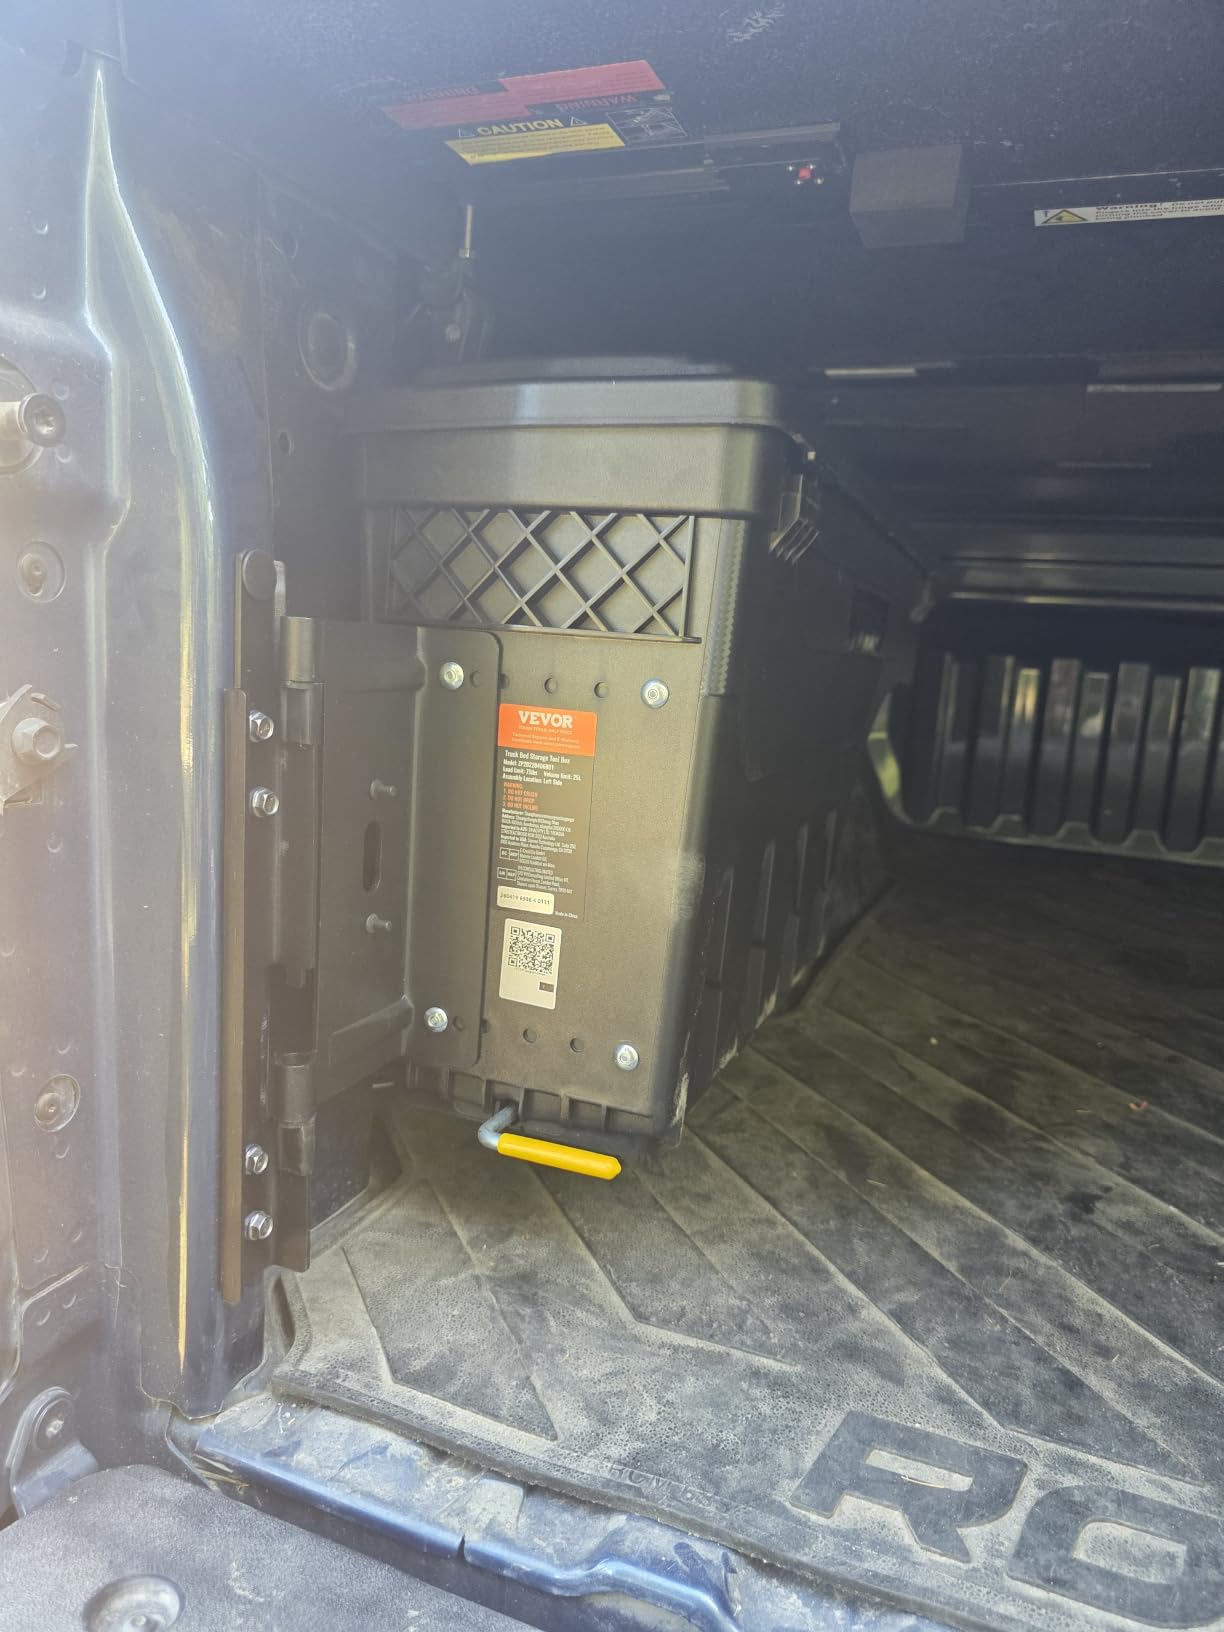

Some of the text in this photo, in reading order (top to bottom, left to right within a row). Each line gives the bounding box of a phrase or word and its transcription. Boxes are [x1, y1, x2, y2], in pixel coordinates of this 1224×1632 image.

[477, 118, 564, 136] CAUTION
[518, 710, 573, 729] VEVOR
[505, 750, 519, 758] Truck
[519, 751, 529, 759] Bed
[530, 752, 549, 762] Storage
